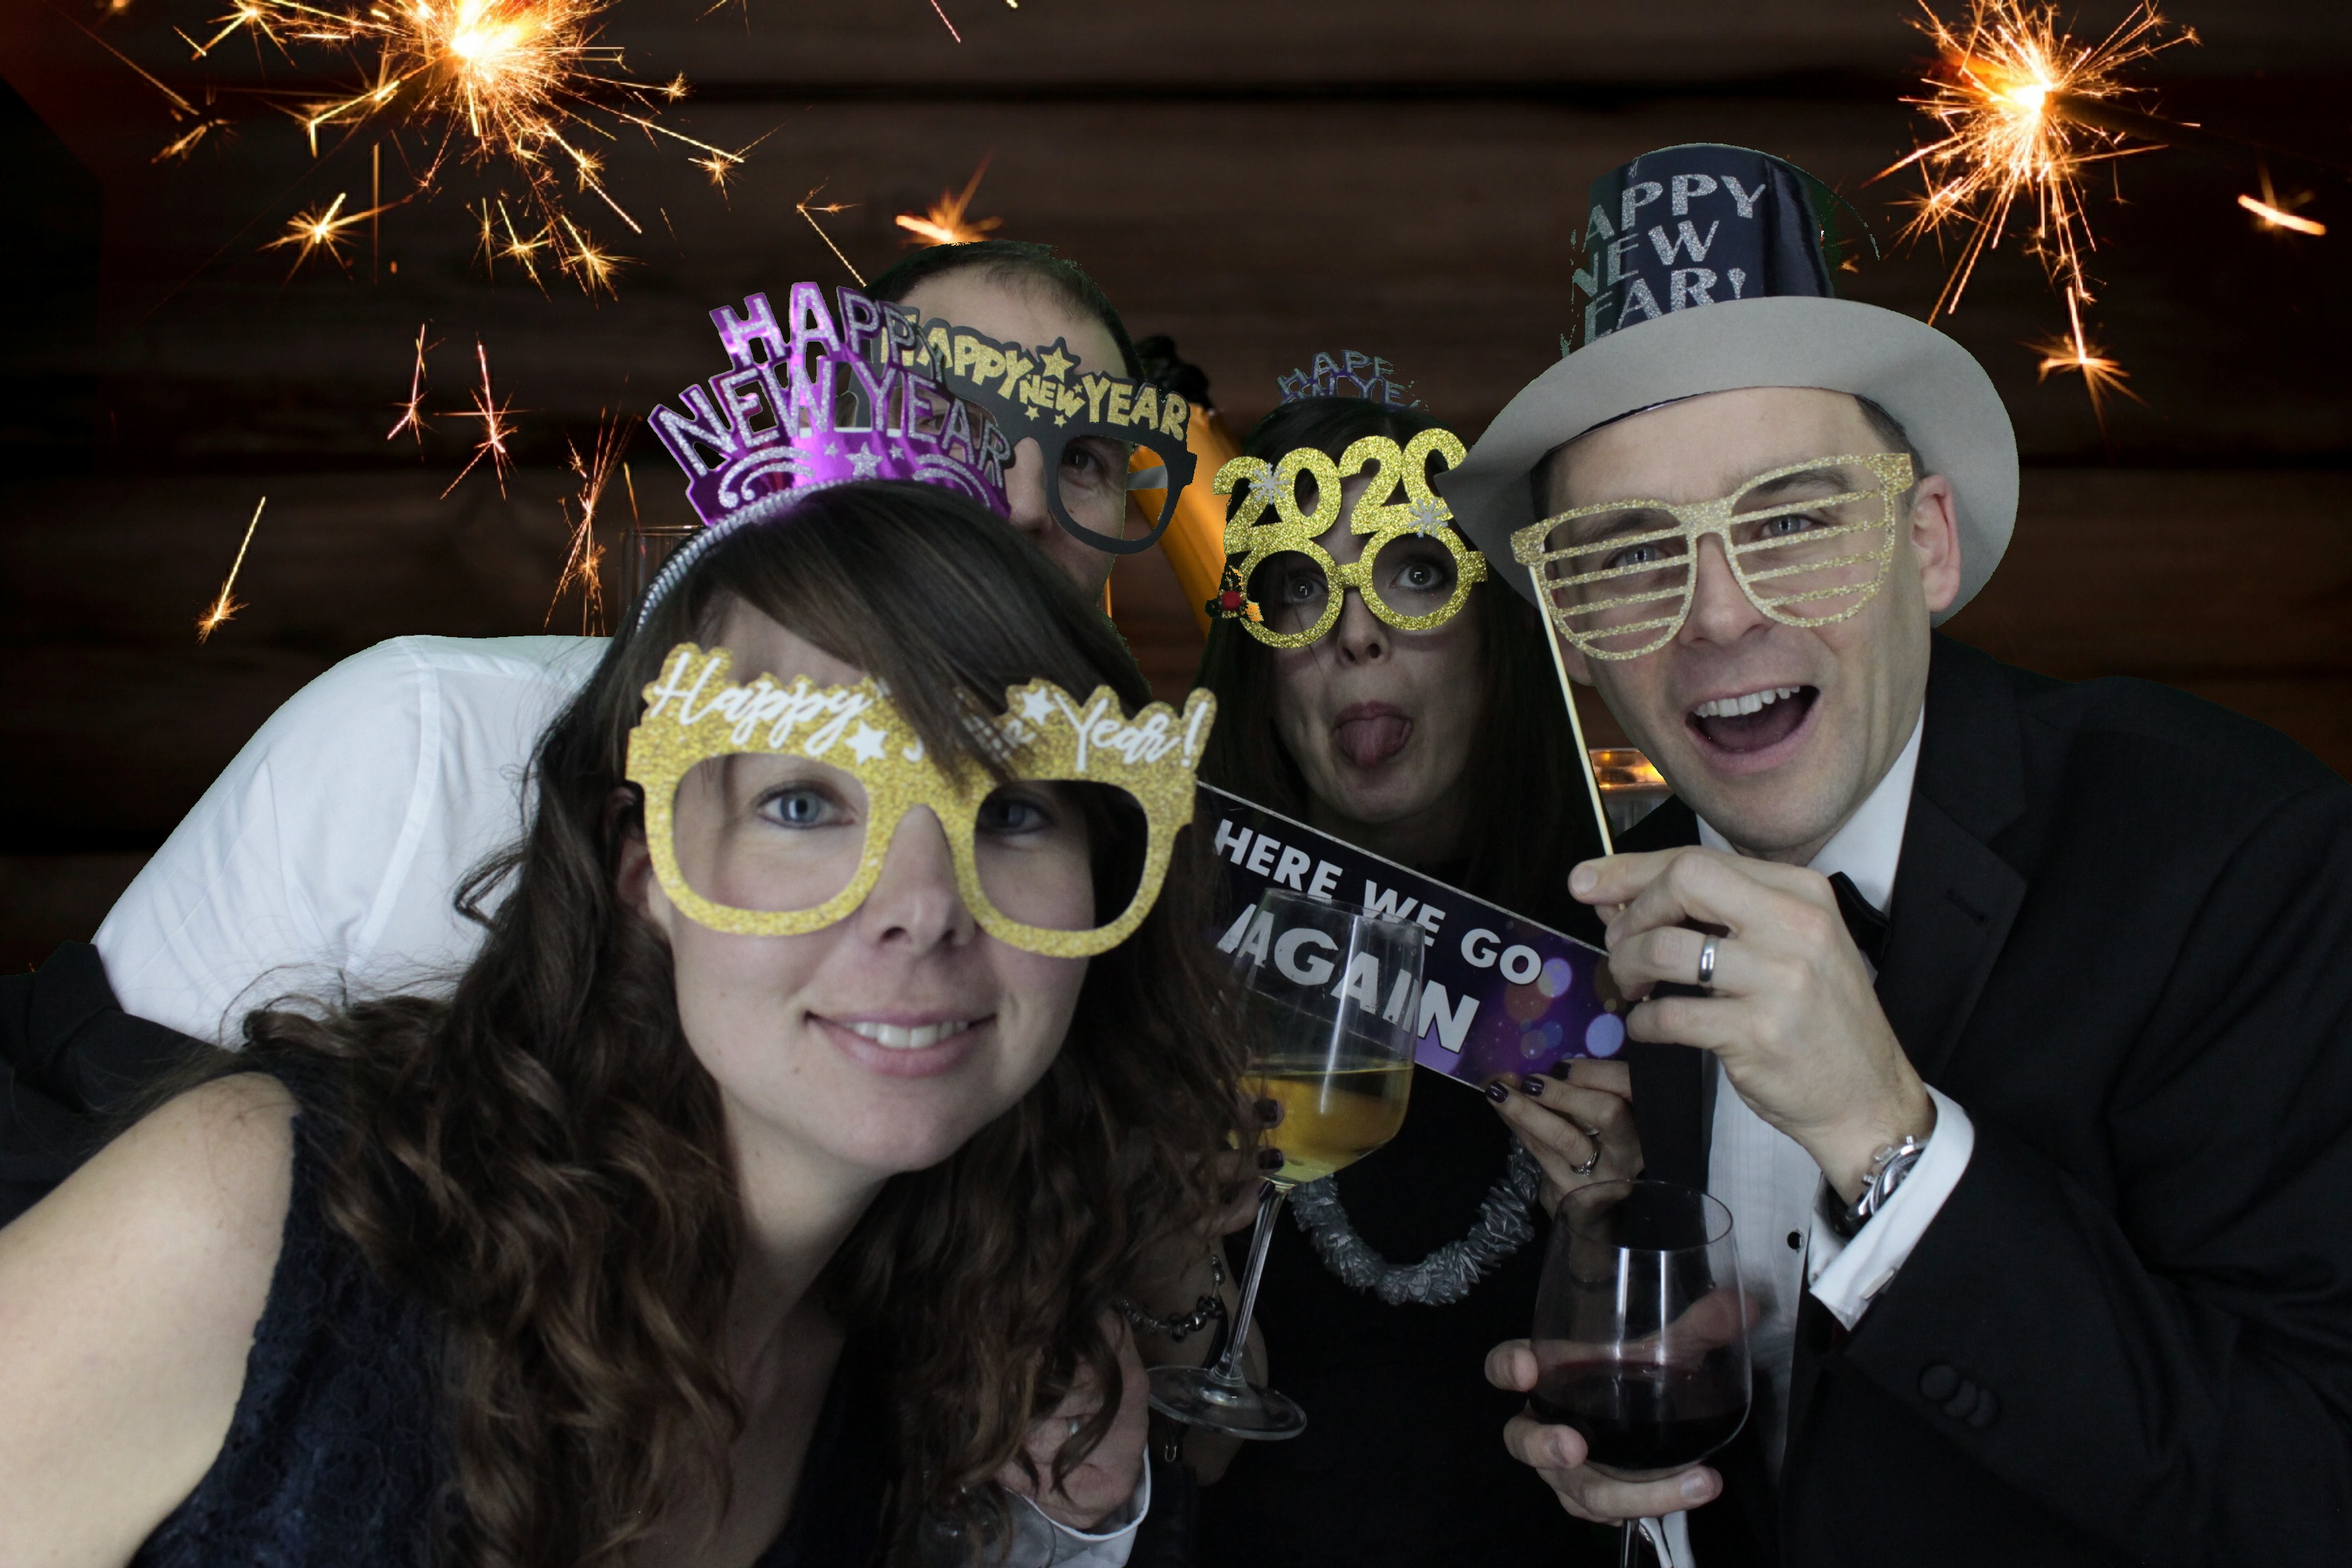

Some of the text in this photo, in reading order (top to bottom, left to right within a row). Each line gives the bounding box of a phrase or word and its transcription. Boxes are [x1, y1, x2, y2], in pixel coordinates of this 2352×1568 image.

[1572, 220, 1720, 301] NEW
[1581, 174, 1766, 253] APPY
[717, 284, 945, 382] HAPPY
[657, 359, 1013, 489] NEW YEAR
[1019, 374, 1086, 418] NEW
[1081, 373, 1188, 442] YEAR
[1213, 427, 1469, 555] 2020
[649, 651, 874, 757] Happy
[1214, 819, 1543, 985] HERE WE GO
[1216, 904, 1480, 1054] AGAIN
